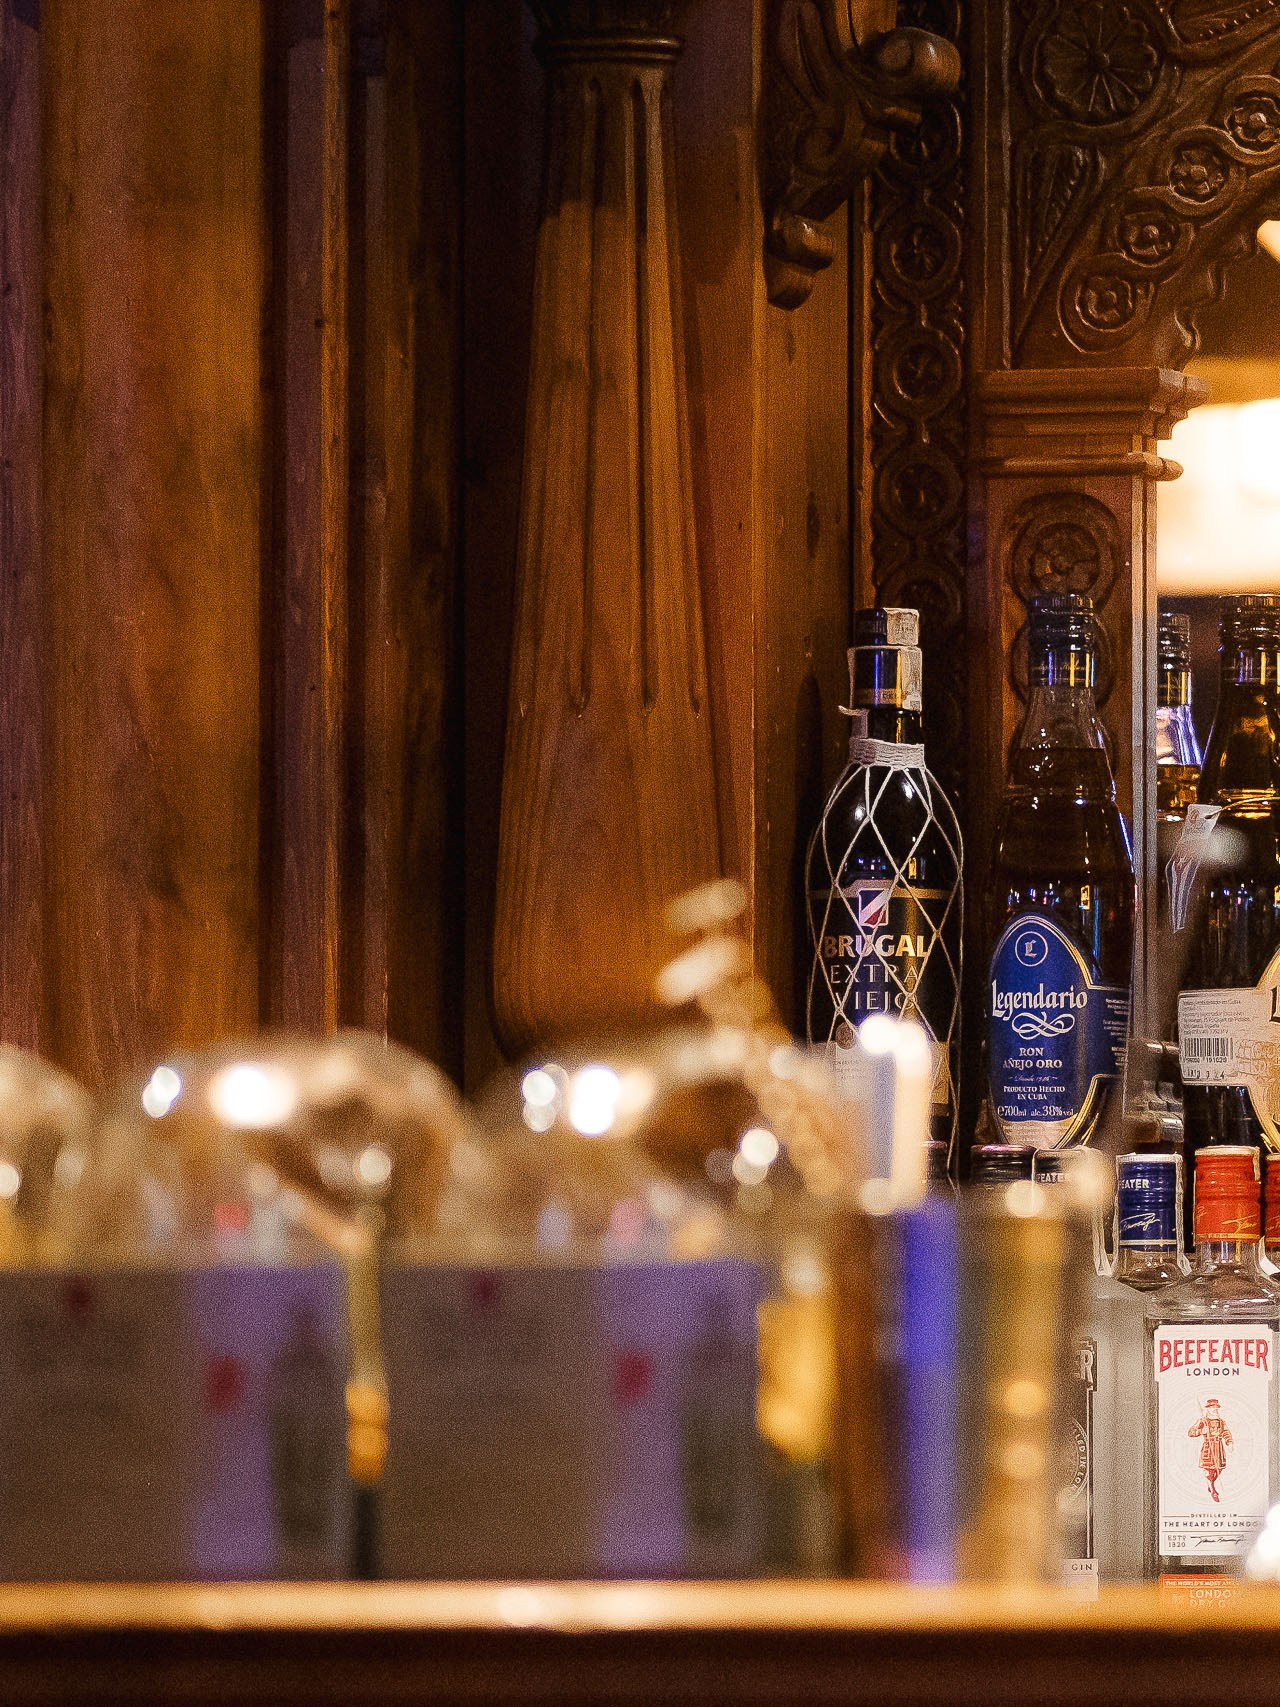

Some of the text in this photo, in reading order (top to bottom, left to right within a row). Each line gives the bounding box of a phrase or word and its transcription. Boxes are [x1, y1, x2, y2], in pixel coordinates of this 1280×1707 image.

[823, 934, 930, 958] BRUGAL
[830, 963, 920, 984] EXTRA
[835, 990, 917, 1013] VIEJO
[991, 978, 1088, 1021] Legendario
[1019, 1047, 1045, 1057] RON
[1002, 1057, 1063, 1071] AÑEJO ORO
[1003, 1085, 1038, 1093] PRODUCTO
[1159, 1338, 1269, 1374] BEEFEATER
[1186, 1367, 1241, 1377] LONDON
[1071, 1562, 1094, 1572] GIN
[1189, 1588, 1232, 1599] LONDO
